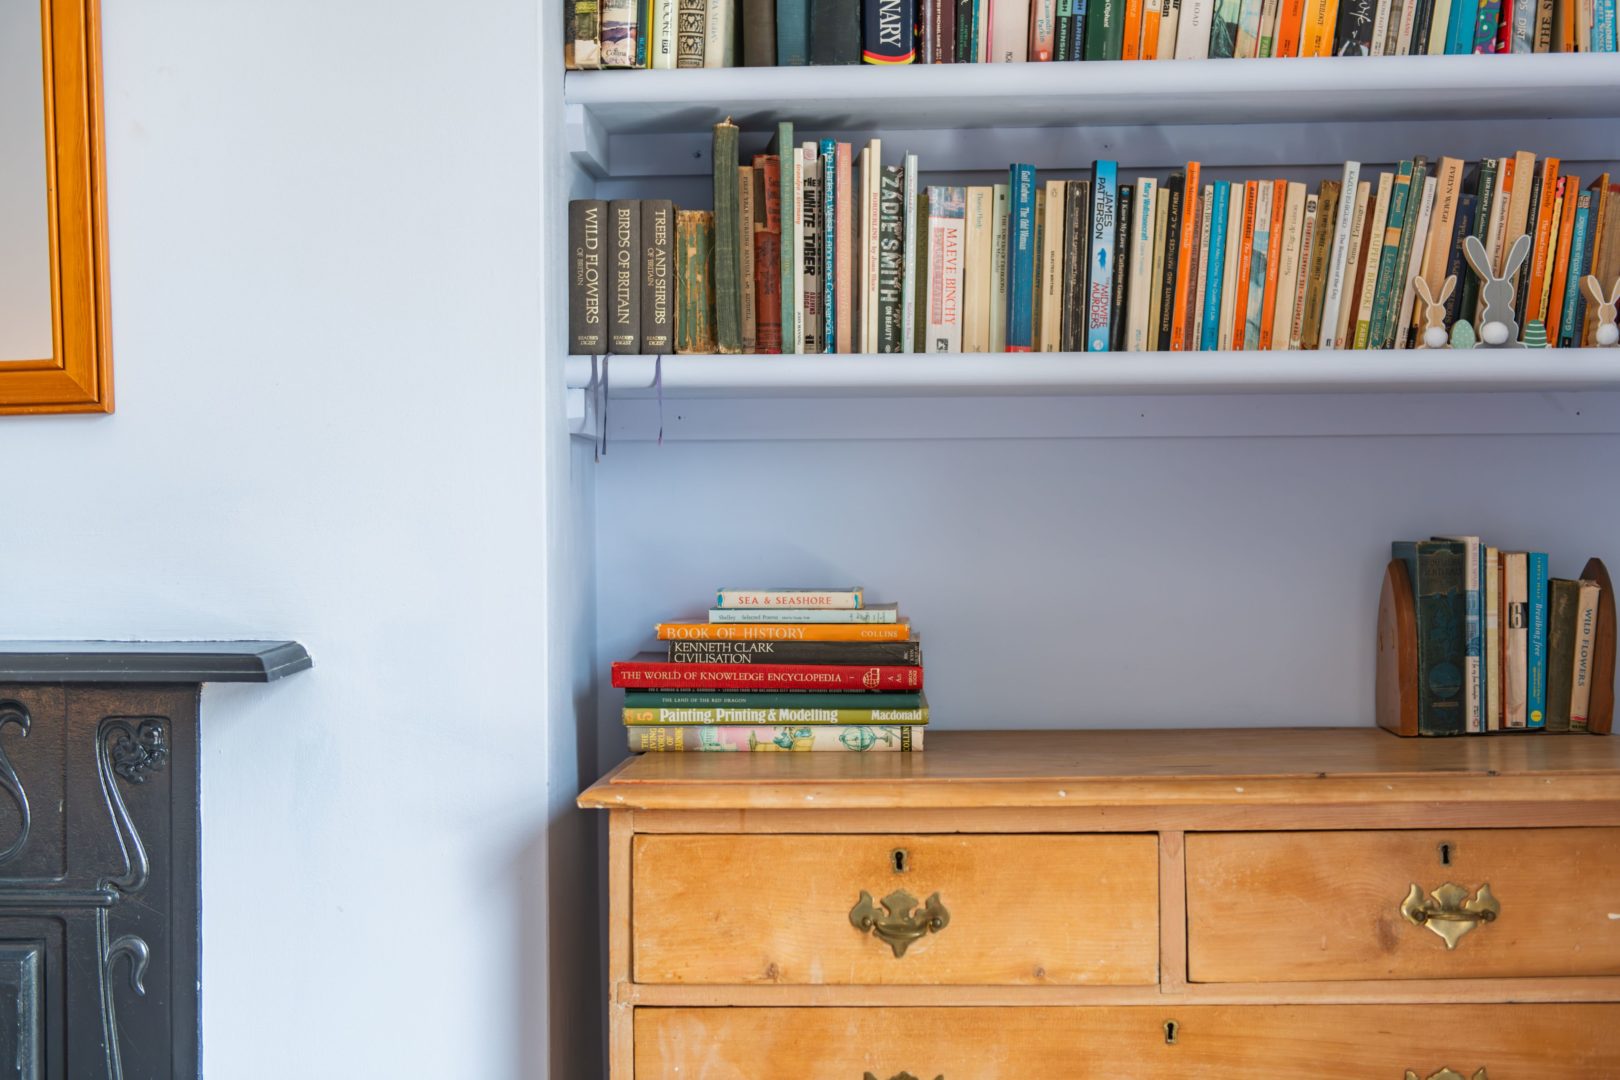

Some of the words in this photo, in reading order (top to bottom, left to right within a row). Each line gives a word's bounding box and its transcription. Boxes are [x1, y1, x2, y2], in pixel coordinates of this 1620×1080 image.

[1192, 2, 1200, 27] ROAD
[1377, 17, 1385, 37] EGYPT
[1059, 17, 1067, 61] EARNSHA
[1517, 18, 1526, 40] DIRT
[1540, 18, 1550, 48] THE
[1605, 10, 1613, 51] HUNDRED
[826, 144, 834, 163] The
[827, 166, 835, 202] Harlech
[1346, 170, 1355, 195] KAZUO
[1446, 166, 1457, 195] EVELYN
[1545, 164, 1556, 187] Penelope
[1142, 182, 1152, 198] Mary
[1395, 192, 1404, 213] Pagnol
[1481, 188, 1491, 212] PEOPLE
[1544, 189, 1553, 208] Lively
[804, 190, 816, 228] WHITE
[880, 177, 899, 232] ZADIE
[1020, 207, 1029, 217] The
[1095, 177, 1105, 240] PATTERSON
[1104, 192, 1113, 227] JAMES
[1342, 195, 1352, 228] ISHIGURO
[1441, 196, 1452, 223] WAUGH
[1499, 196, 1508, 221] Elizabeth
[585, 208, 597, 250] WILD
[618, 209, 629, 247] BIRDS
[655, 210, 665, 246] TREES
[1119, 223, 1127, 232] My
[1140, 199, 1151, 240] Wollstonecraft
[1575, 215, 1585, 234] collier
[577, 248, 583, 257] OF
[647, 248, 654, 257] OF
[945, 228, 957, 273] MAEVE
[1019, 230, 1028, 250] Woman
[1119, 233, 1127, 248] Love
[1369, 233, 1380, 269] RUPERT
[618, 250, 629, 268] OF
[655, 248, 665, 277] AND
[804, 233, 816, 276] TIGER
[1300, 254, 1308, 278] ENFANTS
[1336, 246, 1344, 270] Remains
[1347, 242, 1358, 265] Camus
[1386, 253, 1395, 263] Le
[880, 238, 899, 302] SMITH
[1117, 254, 1125, 284] Catherine
[586, 255, 599, 324] FLOWERS
[617, 271, 629, 324] BRITAIN
[1163, 288, 1171, 332] DETERMINANTS
[1167, 239, 1176, 269] MATRICES
[1362, 272, 1375, 312] BROOKE
[655, 278, 666, 324] SHRUBS
[825, 282, 833, 335] Companion
[885, 306, 892, 315] ON
[945, 278, 957, 325] BINCHY
[1090, 282, 1102, 329] MURDERS
[1099, 284, 1109, 327] MIDWIFE
[1379, 297, 1387, 305] de
[1357, 323, 1367, 347] FABER
[738, 596, 759, 604] SEA
[776, 596, 832, 604] SEASHORE
[667, 627, 710, 639] BOOK
[717, 627, 736, 639] OF
[744, 627, 806, 639] HISTORY
[1533, 603, 1542, 640] Breathing
[1583, 608, 1593, 635] WILD
[674, 642, 731, 652] KENNETH
[734, 642, 774, 653] CLARK
[674, 653, 751, 664] CIVILISATION
[1533, 641, 1542, 656] free
[1578, 640, 1589, 687] FLOWERS
[621, 671, 641, 679] THE
[644, 671, 681, 680] WORLD
[684, 672, 697, 680] OF
[700, 672, 764, 681] KNOWLEDGE
[768, 673, 841, 682] ENCYCLOPEDIA
[636, 711, 653, 721] 5
[660, 708, 714, 724] Painting,
[716, 708, 765, 724] Printing
[768, 710, 776, 722] &
[779, 708, 838, 724] Modelling
[871, 710, 922, 720] Macdonald
[667, 736, 674, 746] OF
[902, 726, 910, 752] COLLIN
